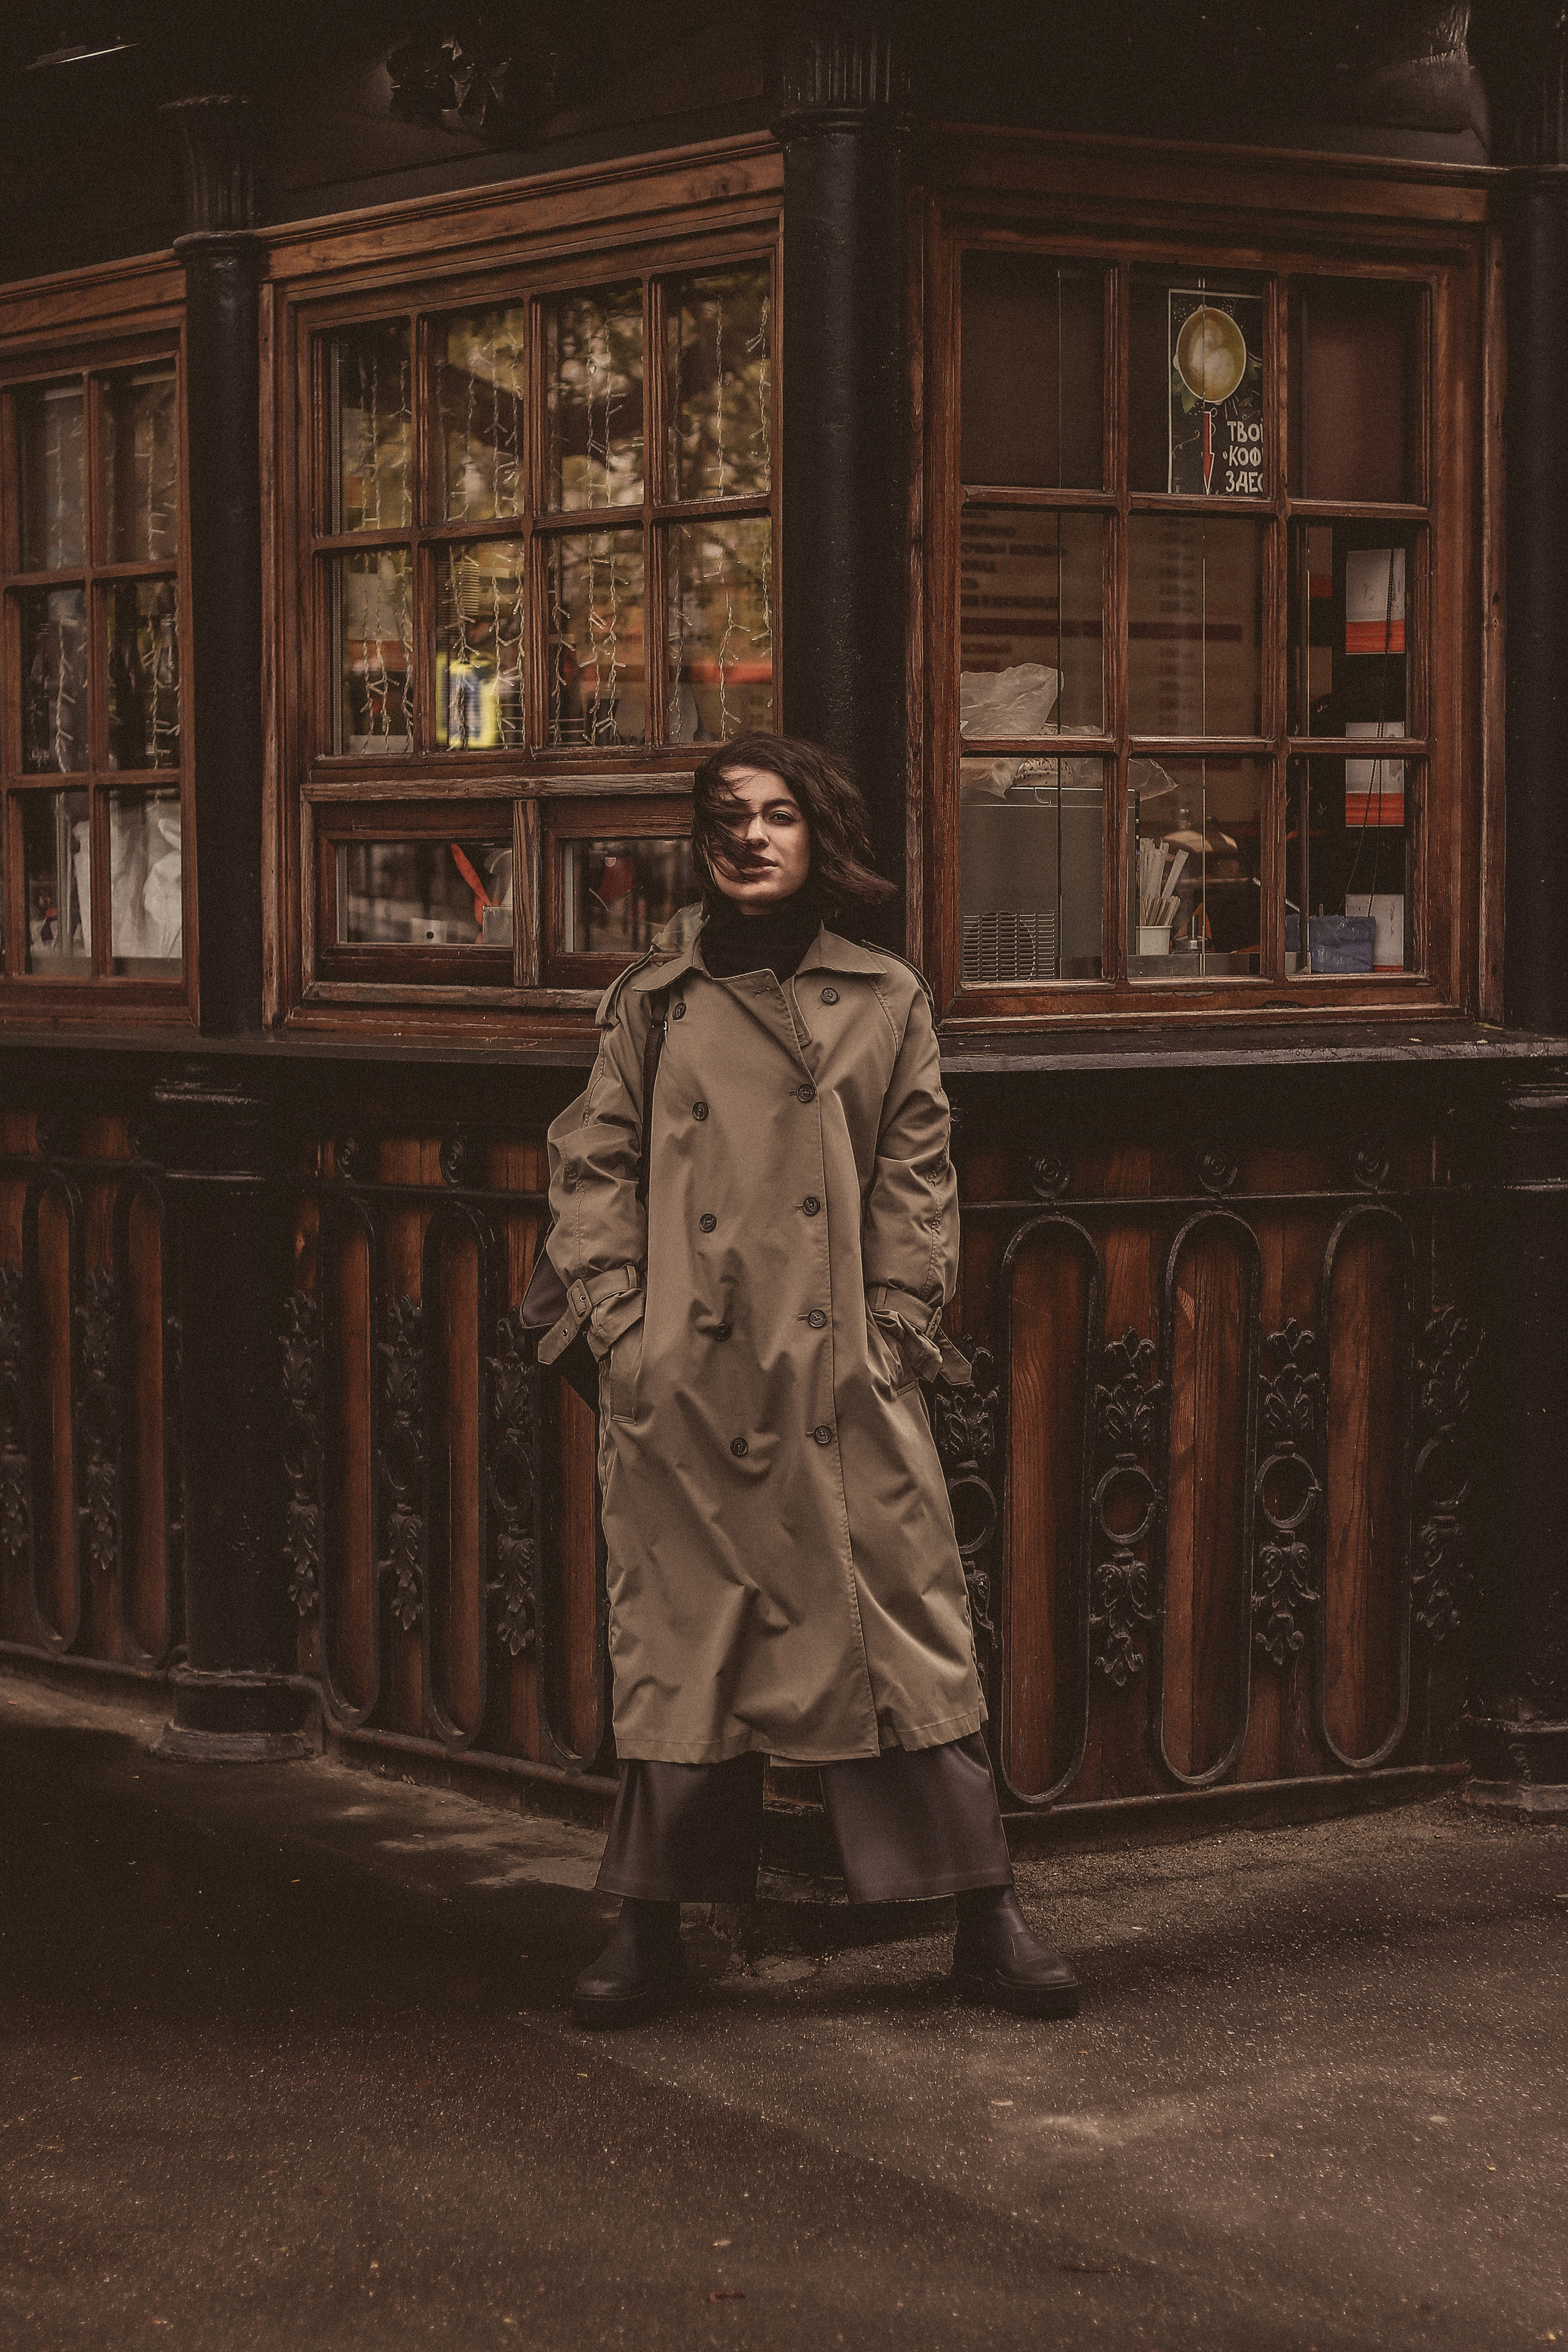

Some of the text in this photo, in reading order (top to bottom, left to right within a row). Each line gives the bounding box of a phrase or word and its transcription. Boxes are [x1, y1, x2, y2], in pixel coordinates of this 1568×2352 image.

[1227, 418, 1263, 442] ТВО
[1229, 445, 1263, 466] КОФ
[1226, 470, 1263, 493] ЗДЕС
